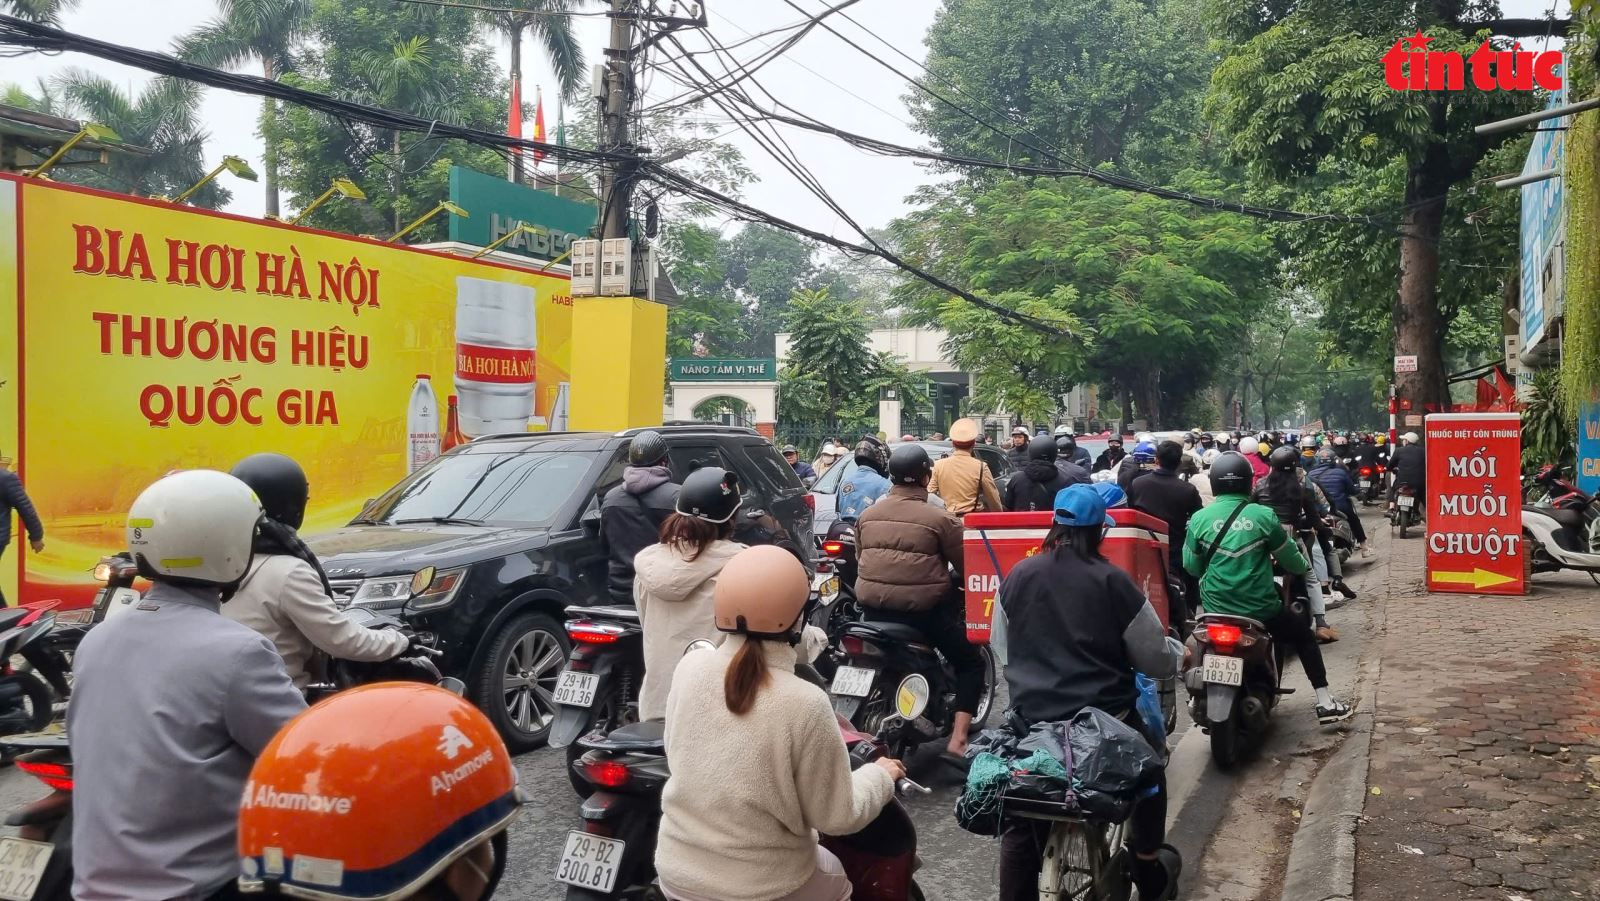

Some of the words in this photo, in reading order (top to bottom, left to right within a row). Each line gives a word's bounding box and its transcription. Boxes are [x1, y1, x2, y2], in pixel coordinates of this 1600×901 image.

[490, 213, 588, 259] HABEC
[72, 223, 156, 282] BIA
[166, 238, 246, 293] HƠI
[256, 245, 311, 300] HÀ
[318, 257, 380, 316] NỘI
[93, 311, 277, 364] THƯƠNG
[291, 325, 369, 372] HIỆU
[459, 355, 473, 373] BIA
[475, 357, 499, 376] HƠI
[502, 356, 518, 376] HÀ
[140, 374, 263, 428] QUỐC
[276, 390, 339, 425] GIA
[1428, 428, 1452, 438] THUỐC
[1454, 430, 1471, 440] DIỆT
[1473, 429, 1490, 438] CÔN
[1492, 429, 1518, 438] TRÙNG
[1448, 446, 1497, 478] MỐI
[1440, 484, 1507, 517] MUỖI
[1213, 517, 1254, 533] Gab
[1429, 527, 1519, 561] CHUỘT
[1206, 670, 1239, 684] 183.70
[1209, 658, 1237, 671] 36-K5
[556, 688, 591, 704] 901.36
[563, 674, 593, 690] 29-N1
[432, 747, 494, 796] Ahamove
[254, 786, 352, 814] Ahamove
[571, 837, 615, 864] 29-B2
[560, 859, 612, 889] 300.81
